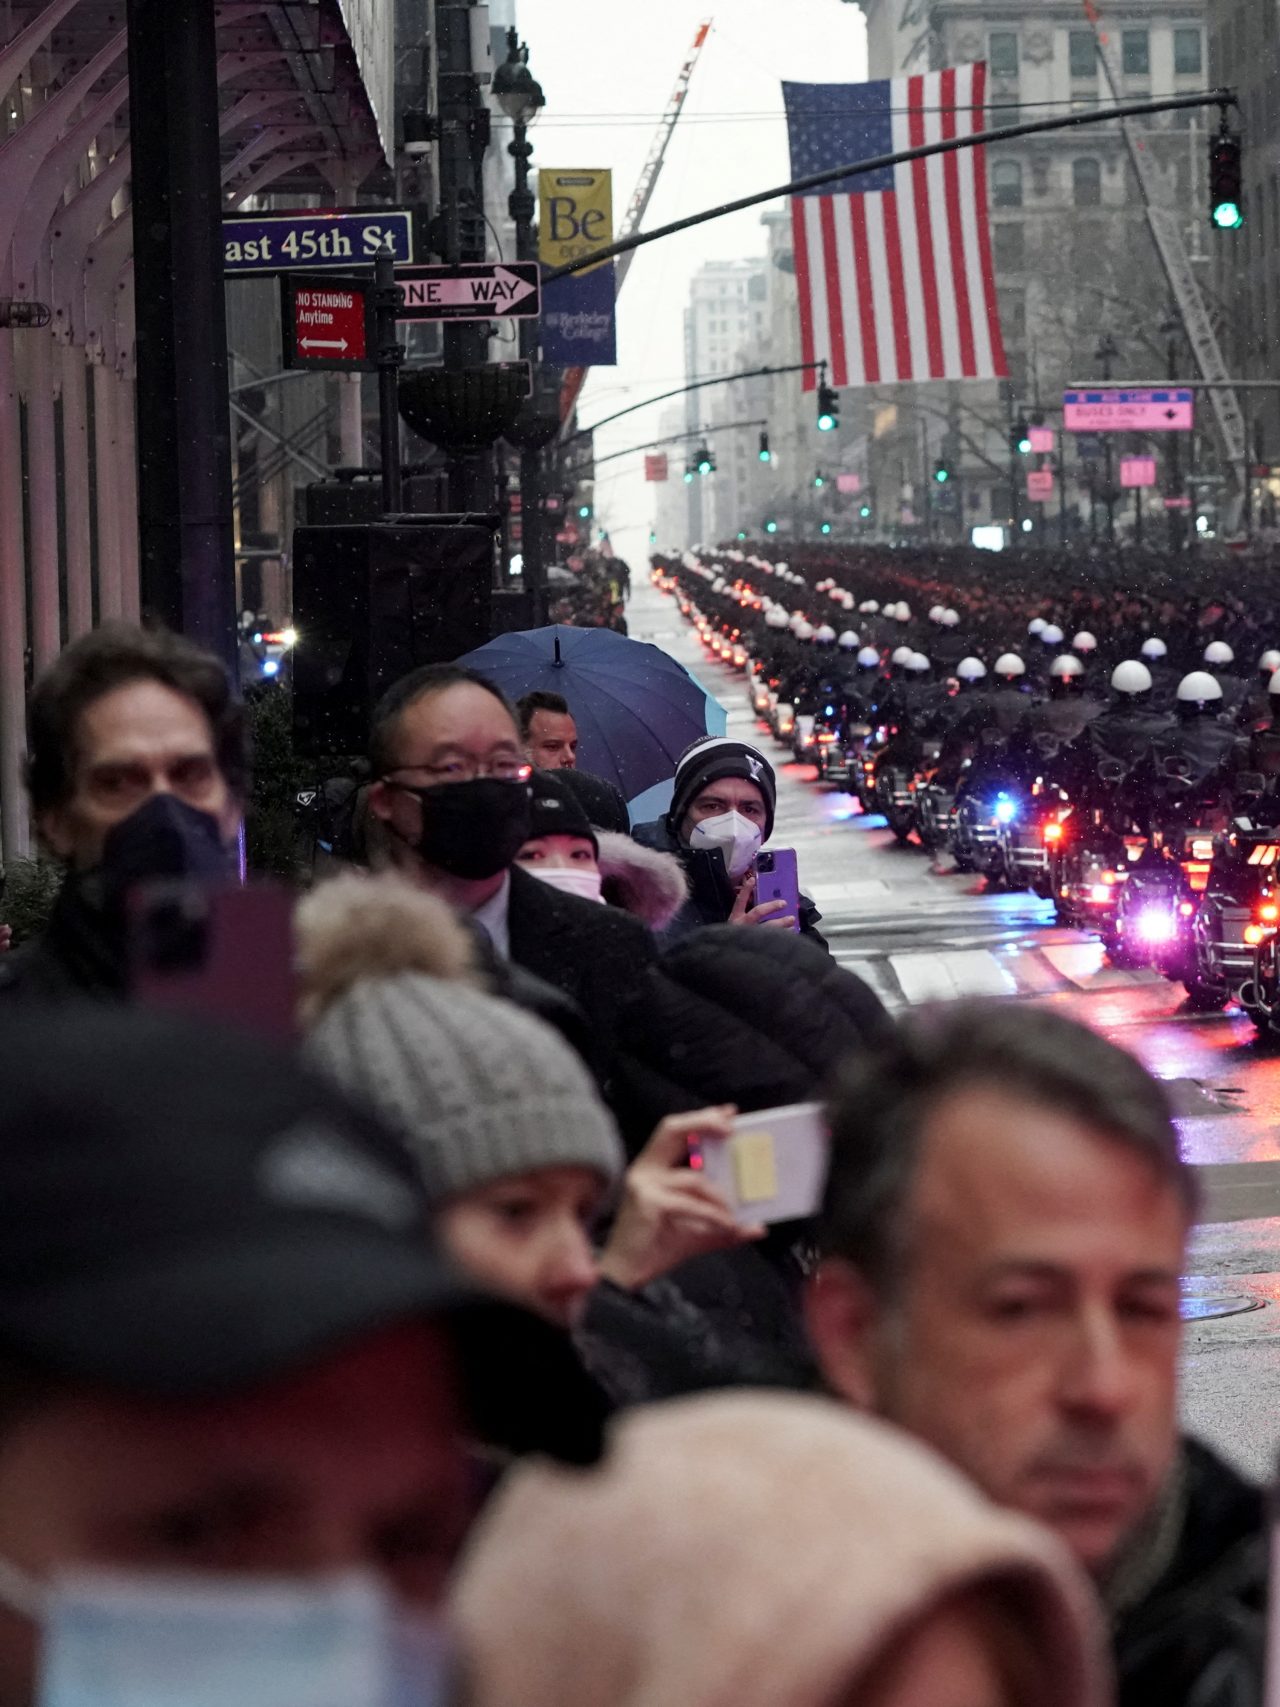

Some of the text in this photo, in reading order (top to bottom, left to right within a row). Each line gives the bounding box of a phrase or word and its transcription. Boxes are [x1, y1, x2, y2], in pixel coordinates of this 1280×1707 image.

[545, 196, 605, 241] Be
[225, 225, 397, 262] ast 45th St
[298, 292, 353, 309] NO STANDING
[470, 280, 520, 301] WAY
[300, 310, 334, 326] Anytime
